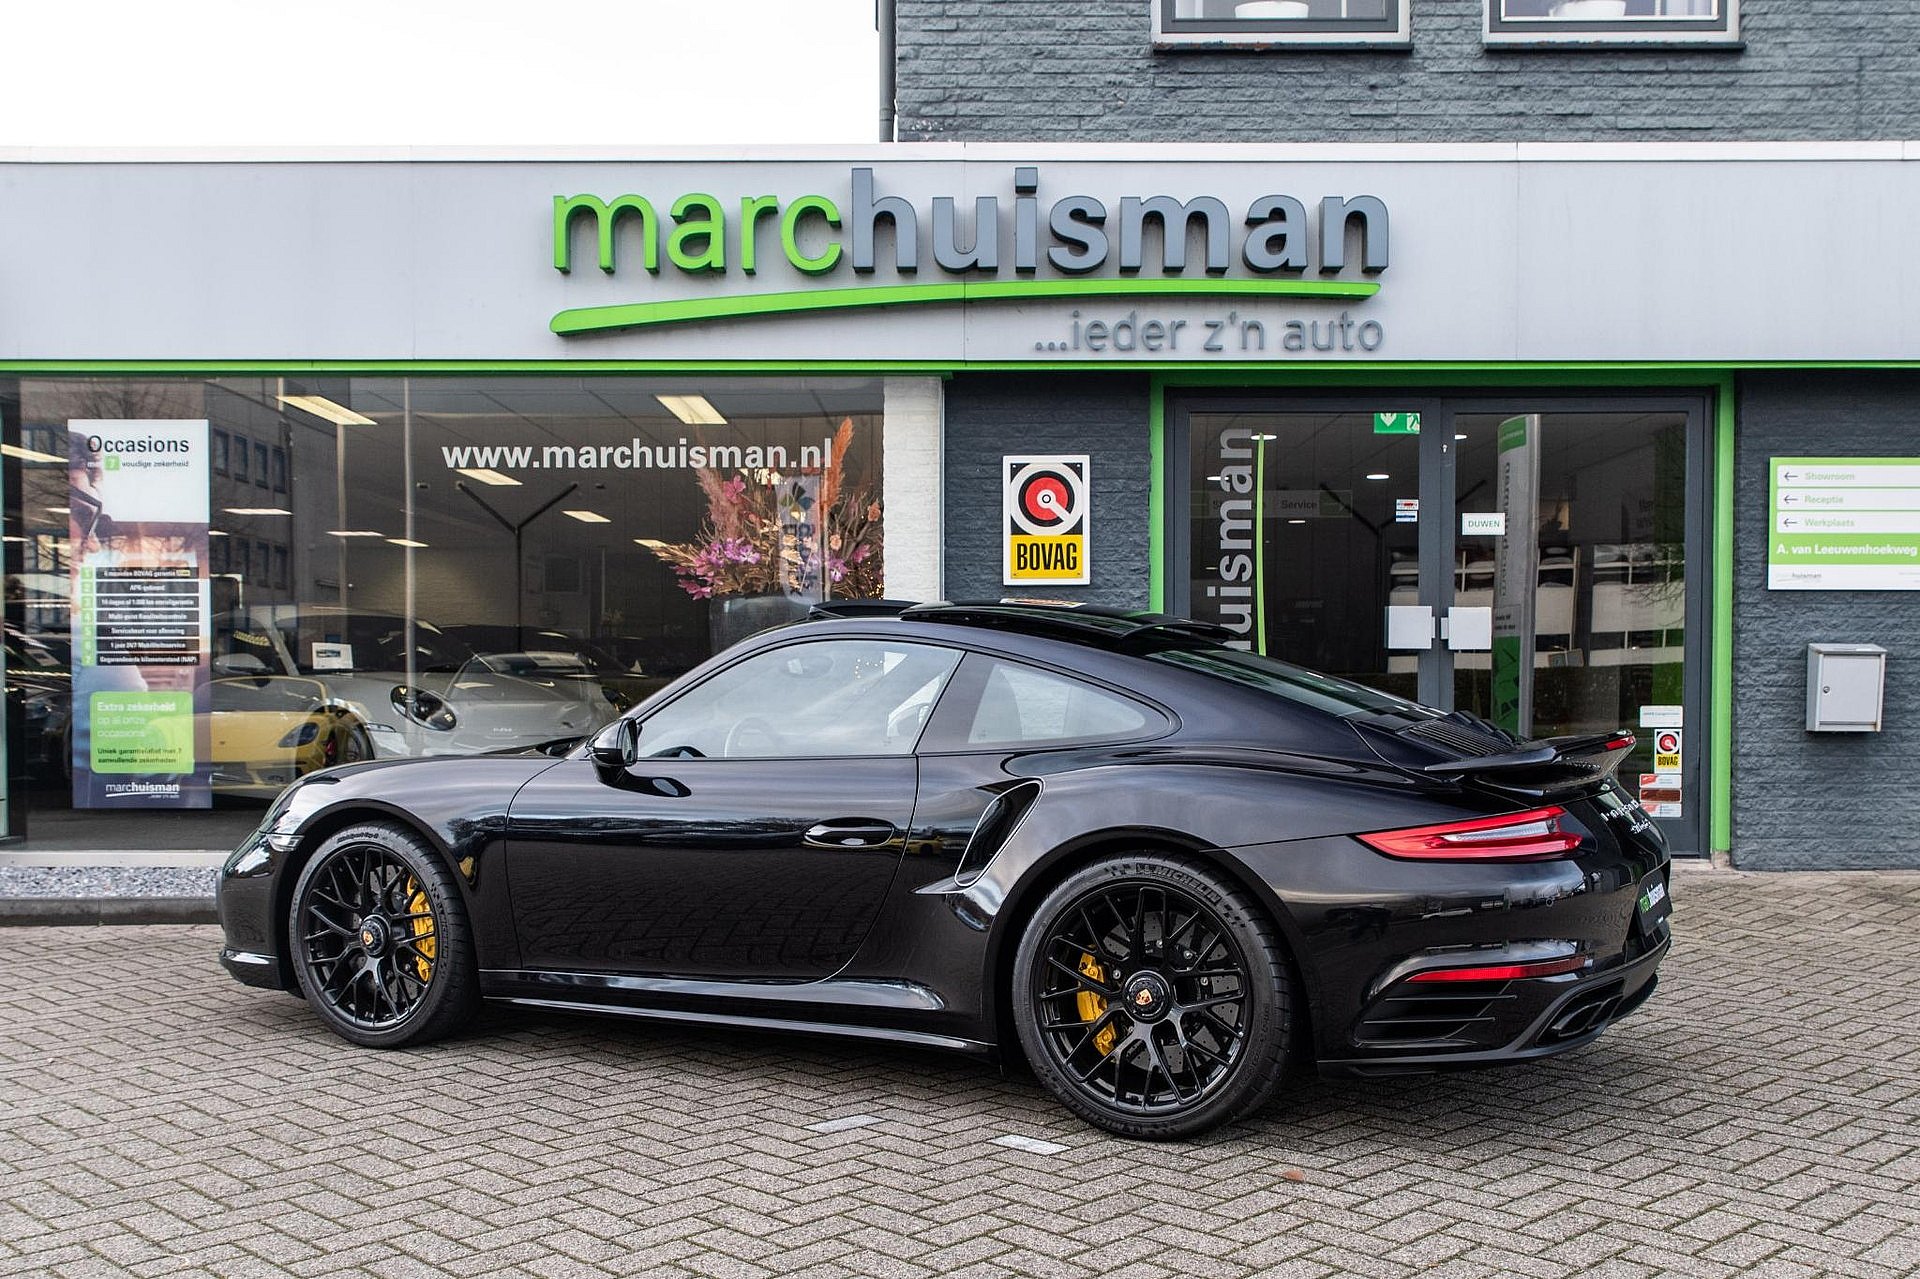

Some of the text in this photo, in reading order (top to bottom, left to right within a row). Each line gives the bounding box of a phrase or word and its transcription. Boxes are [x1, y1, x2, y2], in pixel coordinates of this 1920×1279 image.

[553, 167, 1390, 274] marchuisman
[1034, 310, 1384, 351] ...ieder z'n auto
[88, 435, 189, 453] Occasions
[441, 438, 832, 468] www.marchuisman.nl
[121, 460, 151, 469] voudige
[153, 460, 189, 468] zekerheid
[1804, 472, 1855, 481] Showroom
[1280, 499, 1318, 509] Service
[1804, 495, 1844, 504] Receptie
[1468, 520, 1500, 528] DUWEN
[1804, 518, 1855, 528] Werkplaats
[1207, 428, 1253, 651] uisman
[1776, 543, 1918, 557] A. van Leeuwenhoekweg
[1016, 542, 1077, 571] BOVAG
[97, 702, 176, 711] Extra zekerheid
[1657, 756, 1679, 766] BOVAG
[105, 782, 180, 792] marchuisman
[1152, 865, 1223, 907] MICHELIN
